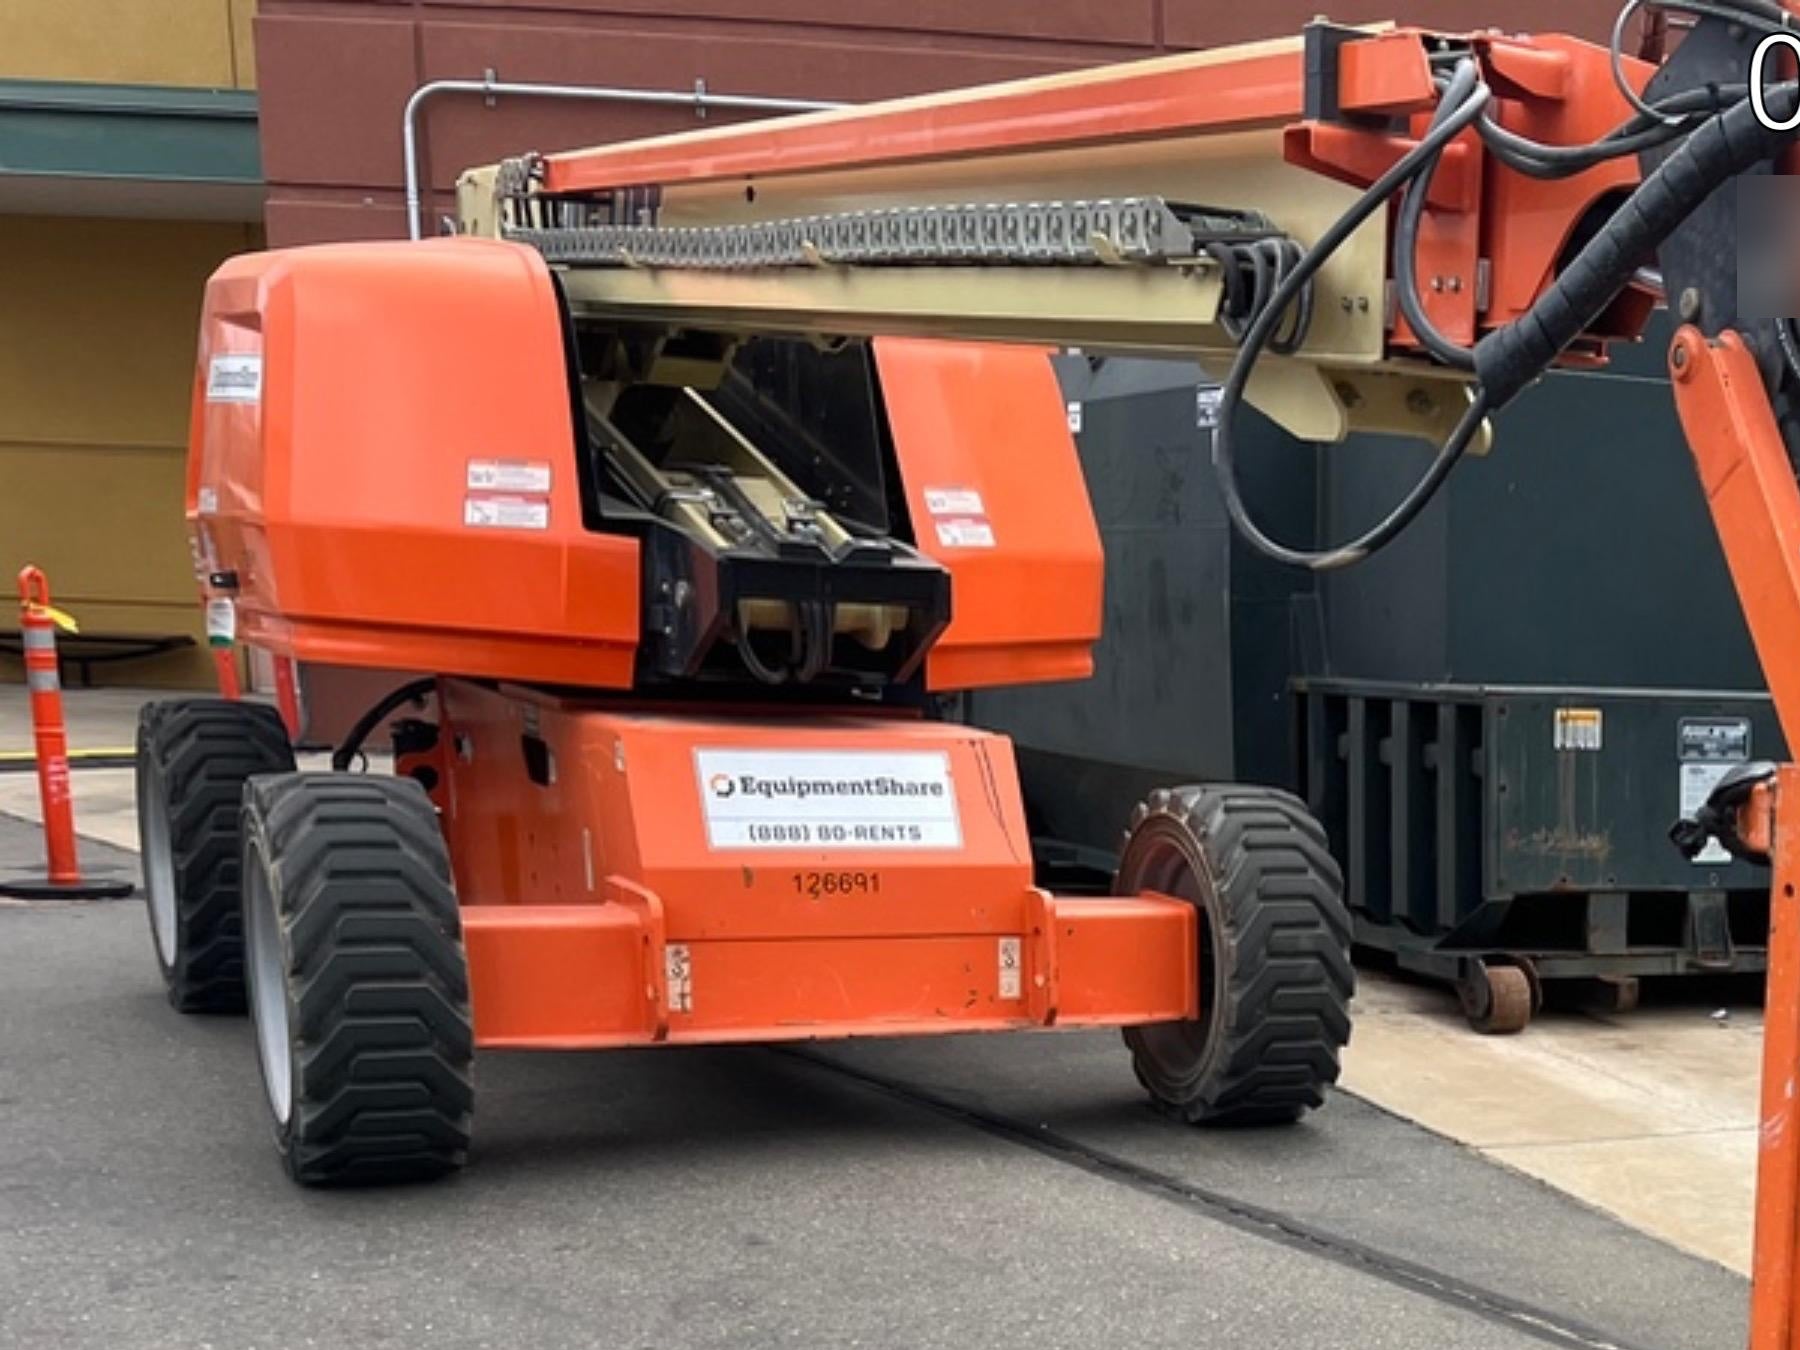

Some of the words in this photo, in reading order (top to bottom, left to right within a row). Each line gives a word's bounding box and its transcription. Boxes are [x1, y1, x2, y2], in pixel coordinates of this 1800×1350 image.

[738, 776, 944, 798] EquipmentShare
[748, 823, 810, 842] (888)
[817, 823, 923, 842] 80-RENTS
[793, 872, 880, 894] 126691
